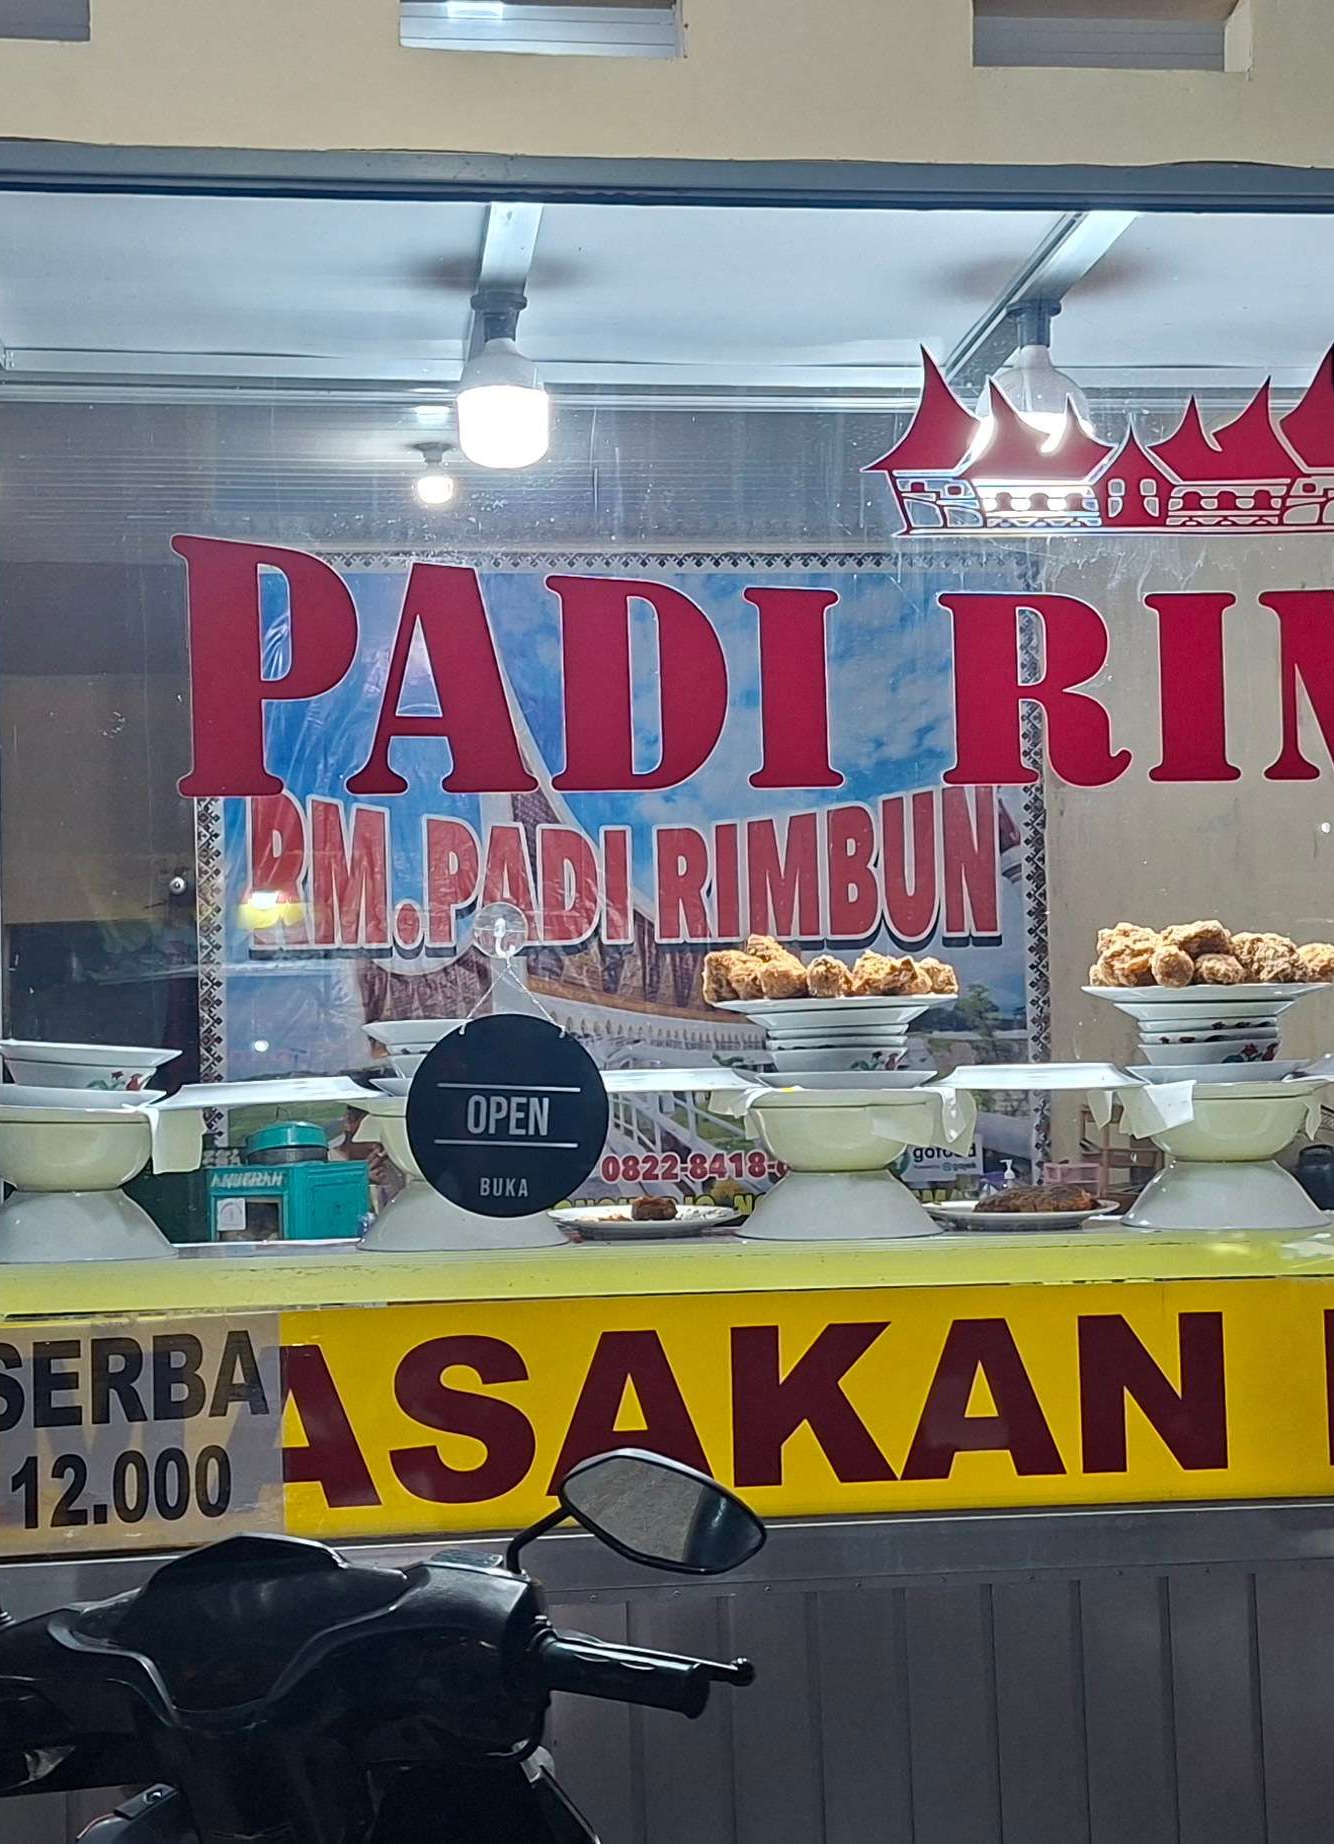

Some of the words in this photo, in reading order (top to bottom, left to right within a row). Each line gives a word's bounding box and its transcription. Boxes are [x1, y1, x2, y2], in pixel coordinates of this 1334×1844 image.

[170, 533, 846, 798] PADI
[655, 783, 1003, 945] RIMBUN
[466, 1094, 550, 1137] OPEN
[479, 1176, 529, 1198] BUKA
[9, 1444, 232, 1530] 12.000
